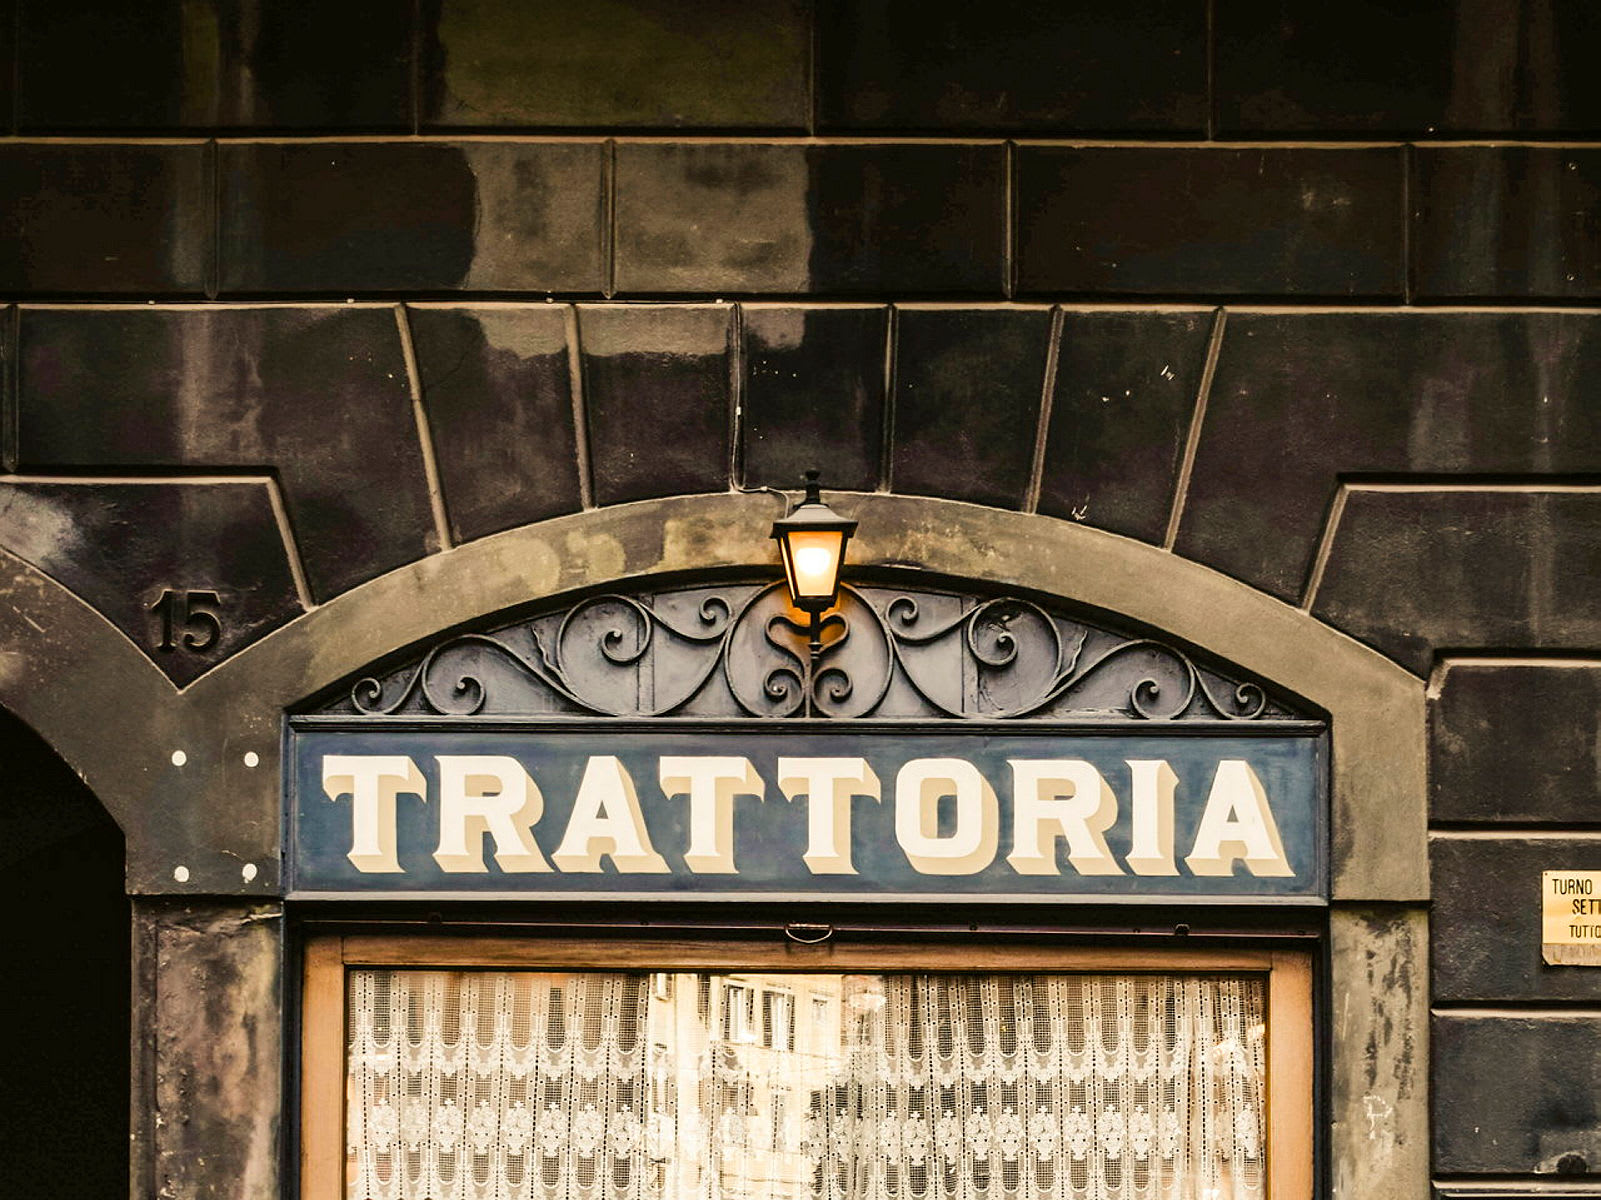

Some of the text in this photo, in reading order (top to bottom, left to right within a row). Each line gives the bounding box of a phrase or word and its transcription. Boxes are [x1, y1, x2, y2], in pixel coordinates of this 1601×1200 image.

[151, 588, 221, 651] 15
[321, 755, 1296, 878] TRATTORIA
[1552, 878, 1593, 895] TURNO
